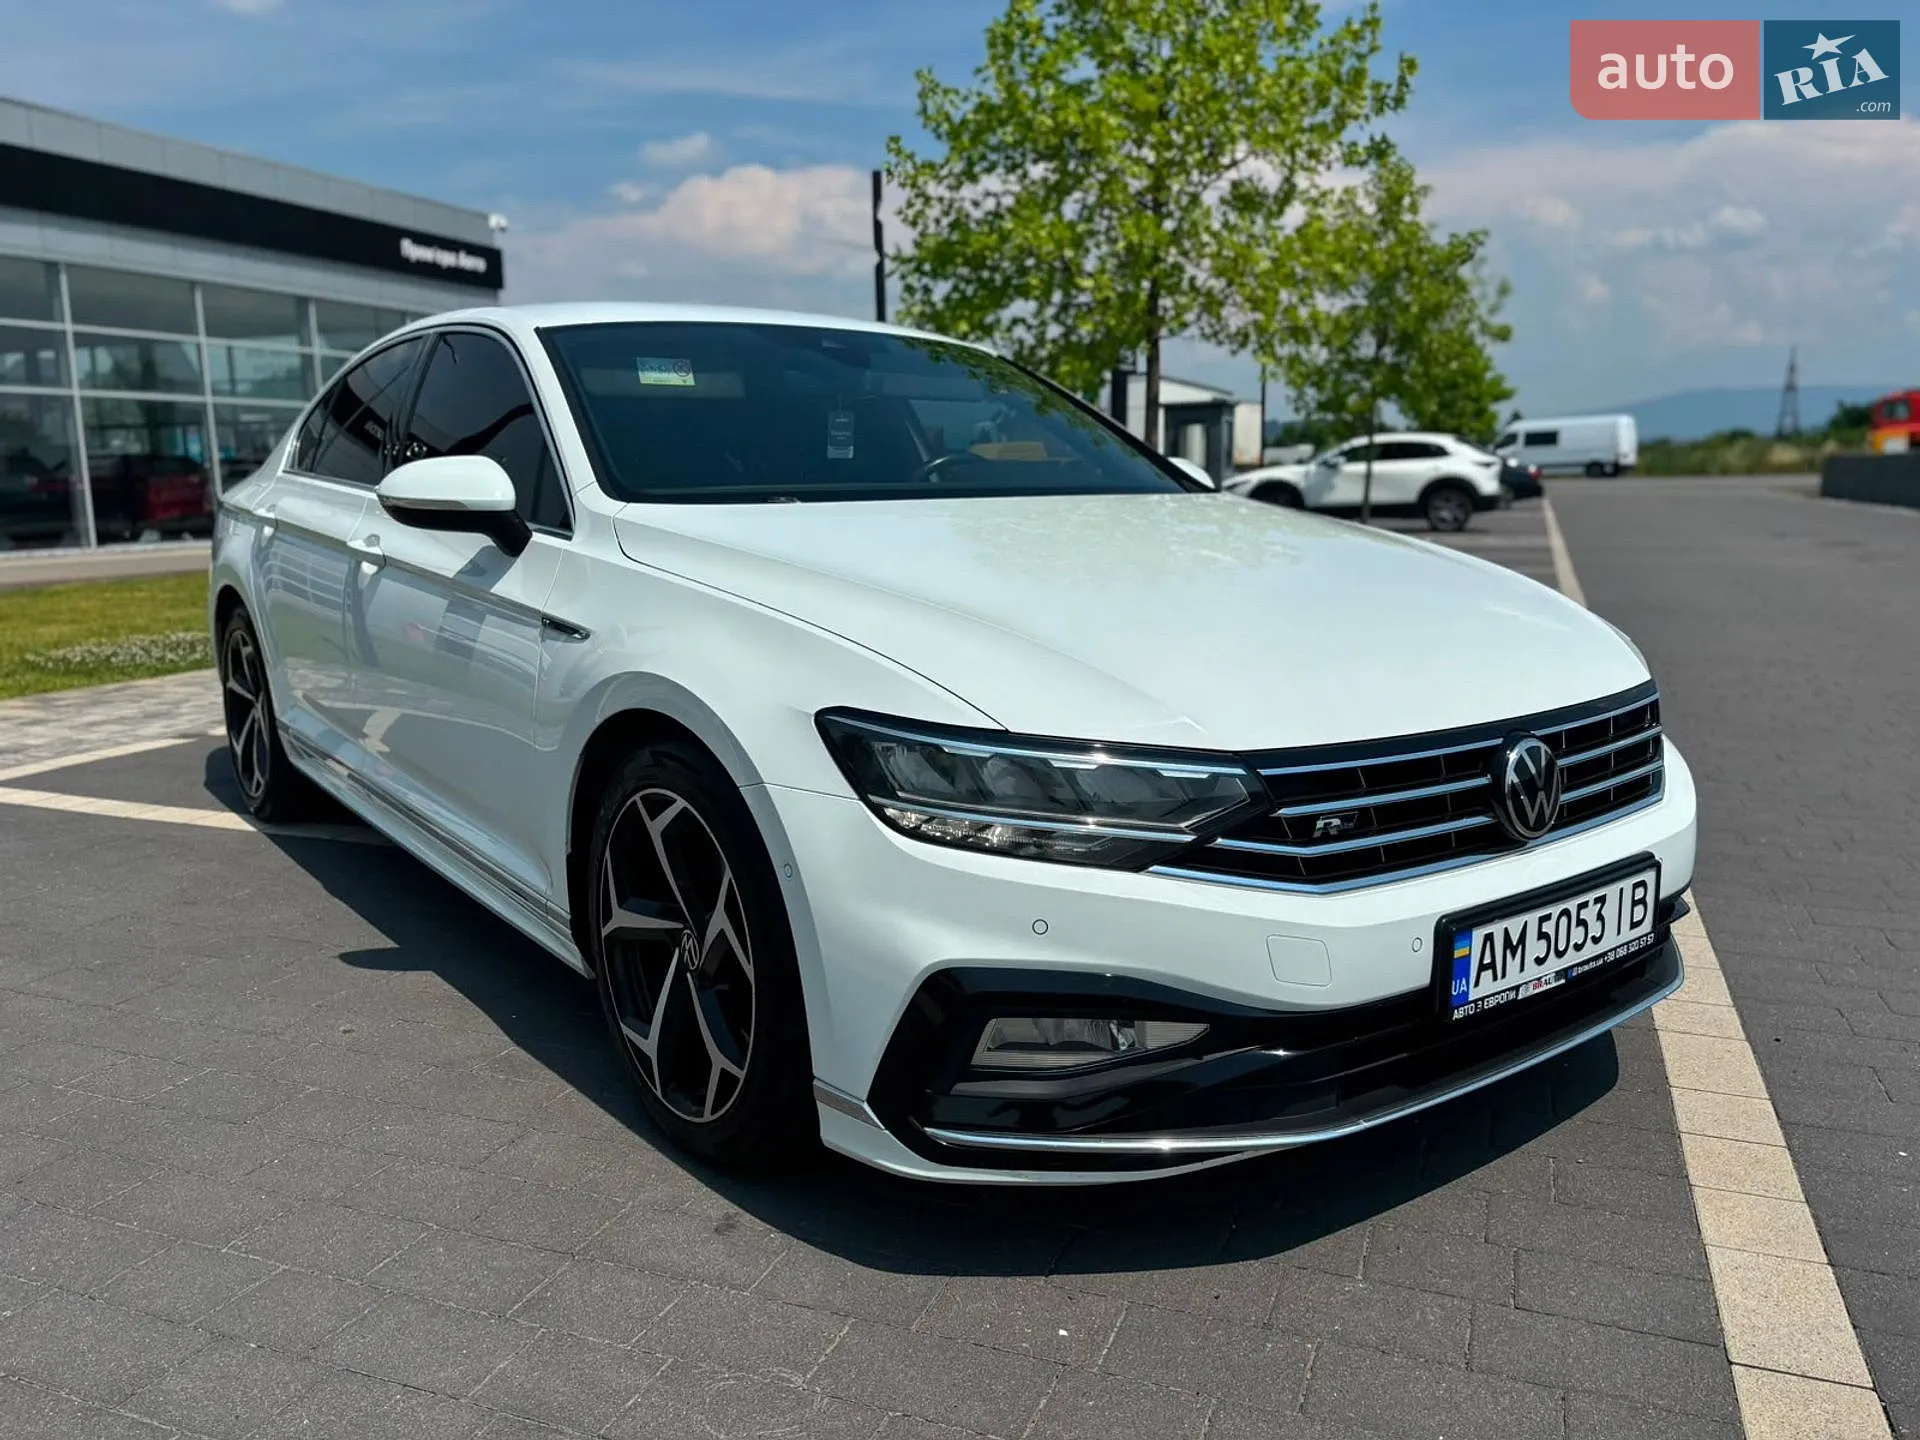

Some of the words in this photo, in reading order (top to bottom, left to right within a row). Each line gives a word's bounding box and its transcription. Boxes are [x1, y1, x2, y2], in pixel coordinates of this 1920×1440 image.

[1473, 920, 1528, 988] AM
[1533, 893, 1608, 966] 5053
[1616, 879, 1649, 938] IB
[1451, 977, 1468, 996] UA
[1452, 1003, 1475, 1021] АВТО
